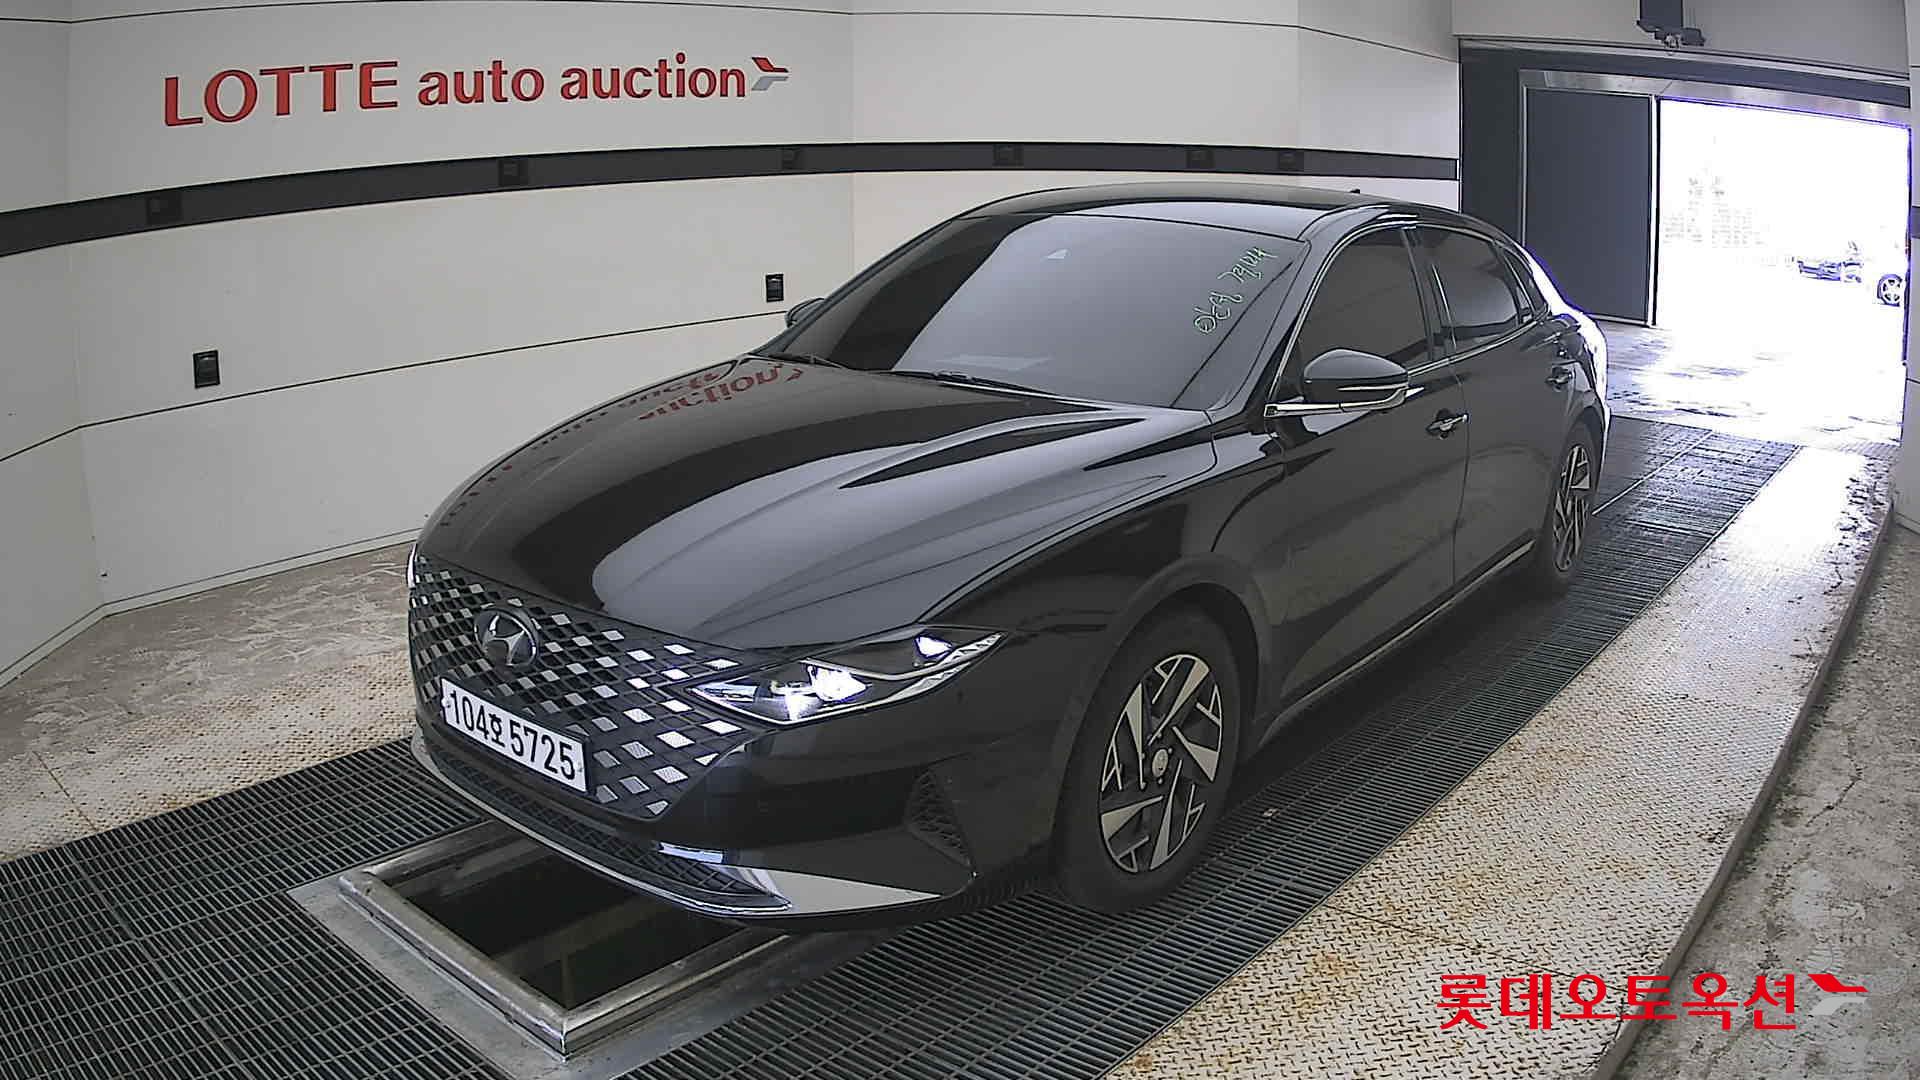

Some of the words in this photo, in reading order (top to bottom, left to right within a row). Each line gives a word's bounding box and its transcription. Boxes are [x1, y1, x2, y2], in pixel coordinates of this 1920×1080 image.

[163, 61, 399, 127] LOTTE
[417, 60, 545, 106] auto
[560, 52, 746, 101] auction
[450, 690, 505, 748] 104호
[509, 719, 576, 780] 5725
